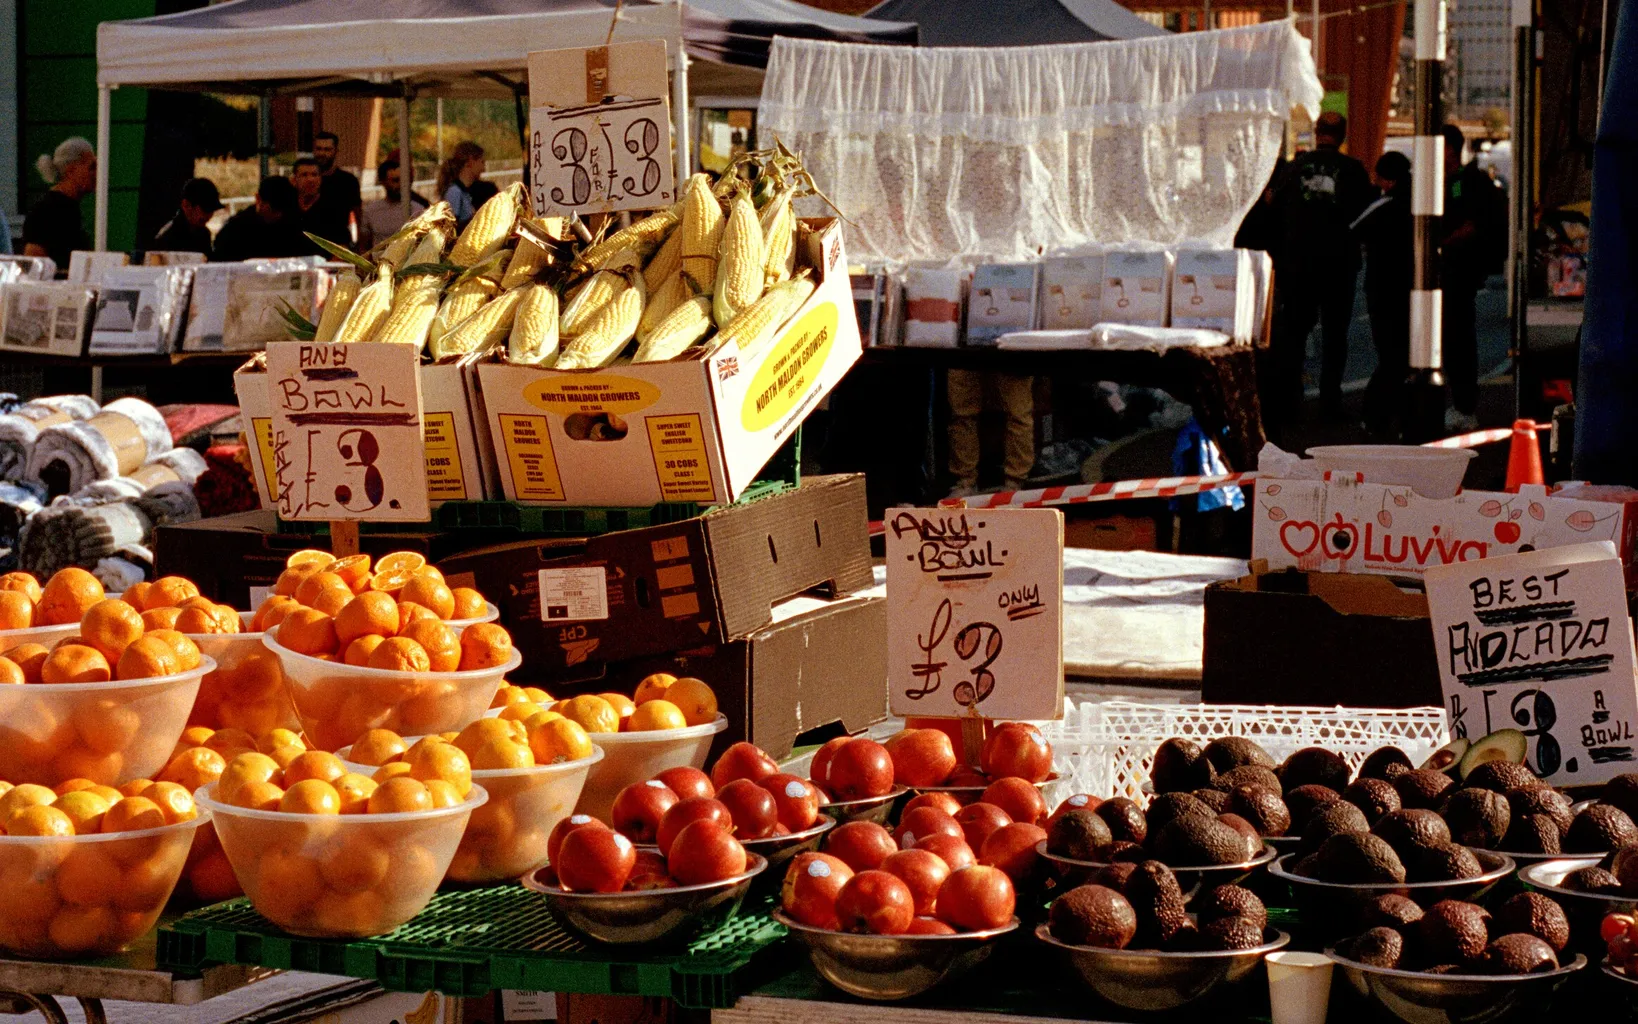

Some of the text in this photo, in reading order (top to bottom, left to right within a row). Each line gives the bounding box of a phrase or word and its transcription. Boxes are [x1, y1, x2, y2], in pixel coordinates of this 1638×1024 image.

[300, 345, 348, 368] ANY
[756, 325, 828, 414] NORTH MALDON GROWERS
[278, 378, 406, 412] BOWL
[541, 391, 641, 402] NORTH MALDON GROWERS
[661, 437, 693, 445] SWEETCORN
[430, 458, 451, 466] COBS
[664, 459, 699, 469] 30 COBS
[998, 583, 1040, 609] ONLY
[1468, 568, 1569, 608] BEST
[1580, 720, 1635, 747] BOWL
